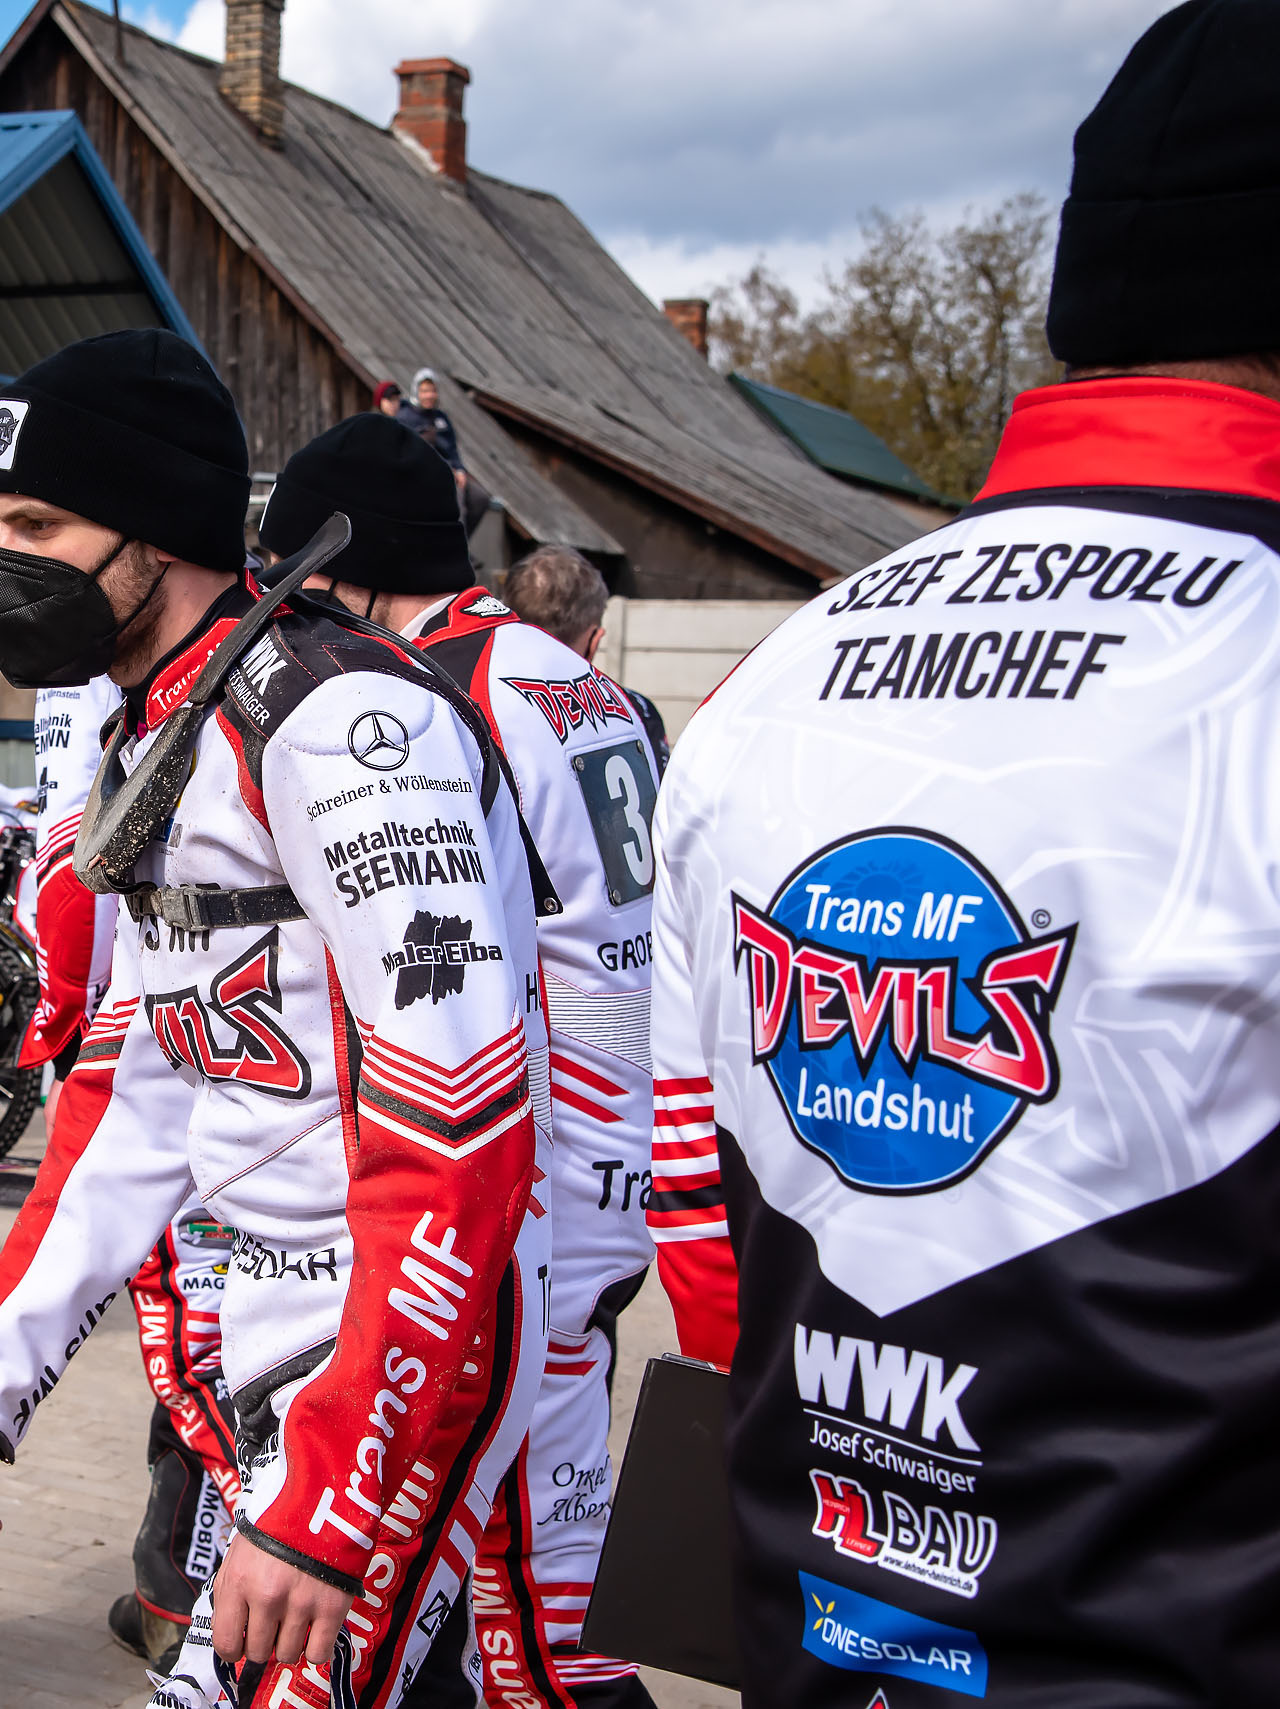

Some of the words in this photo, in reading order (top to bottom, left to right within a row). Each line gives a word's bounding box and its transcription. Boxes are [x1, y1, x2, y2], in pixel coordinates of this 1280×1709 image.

[827, 549, 964, 616] SZEF
[946, 543, 1244, 608] ZESPOŁU
[819, 630, 1127, 701] TEAMCHEF
[307, 784, 374, 821] Schreiner
[380, 780, 391, 793] &
[393, 775, 472, 793] Wöllenstein
[605, 755, 653, 886] 3
[324, 818, 475, 871] Metalltechnik
[335, 848, 487, 908] SEEMANN
[805, 884, 905, 937] Trans
[913, 892, 983, 942] MF
[597, 930, 652, 972] GROB
[731, 890, 1079, 1105] DEVILS
[797, 1067, 974, 1144] Landshut
[136, 1290, 168, 1346] MF
[308, 1346, 426, 1551] Trans
[388, 1211, 473, 1340] MF
[794, 1323, 981, 1452] WWK
[809, 1420, 860, 1458] Josef
[863, 1440, 976, 1494] Schwaiger
[537, 1492, 612, 1525] Alber
[822, 1617, 971, 1675] ONESOLAR
